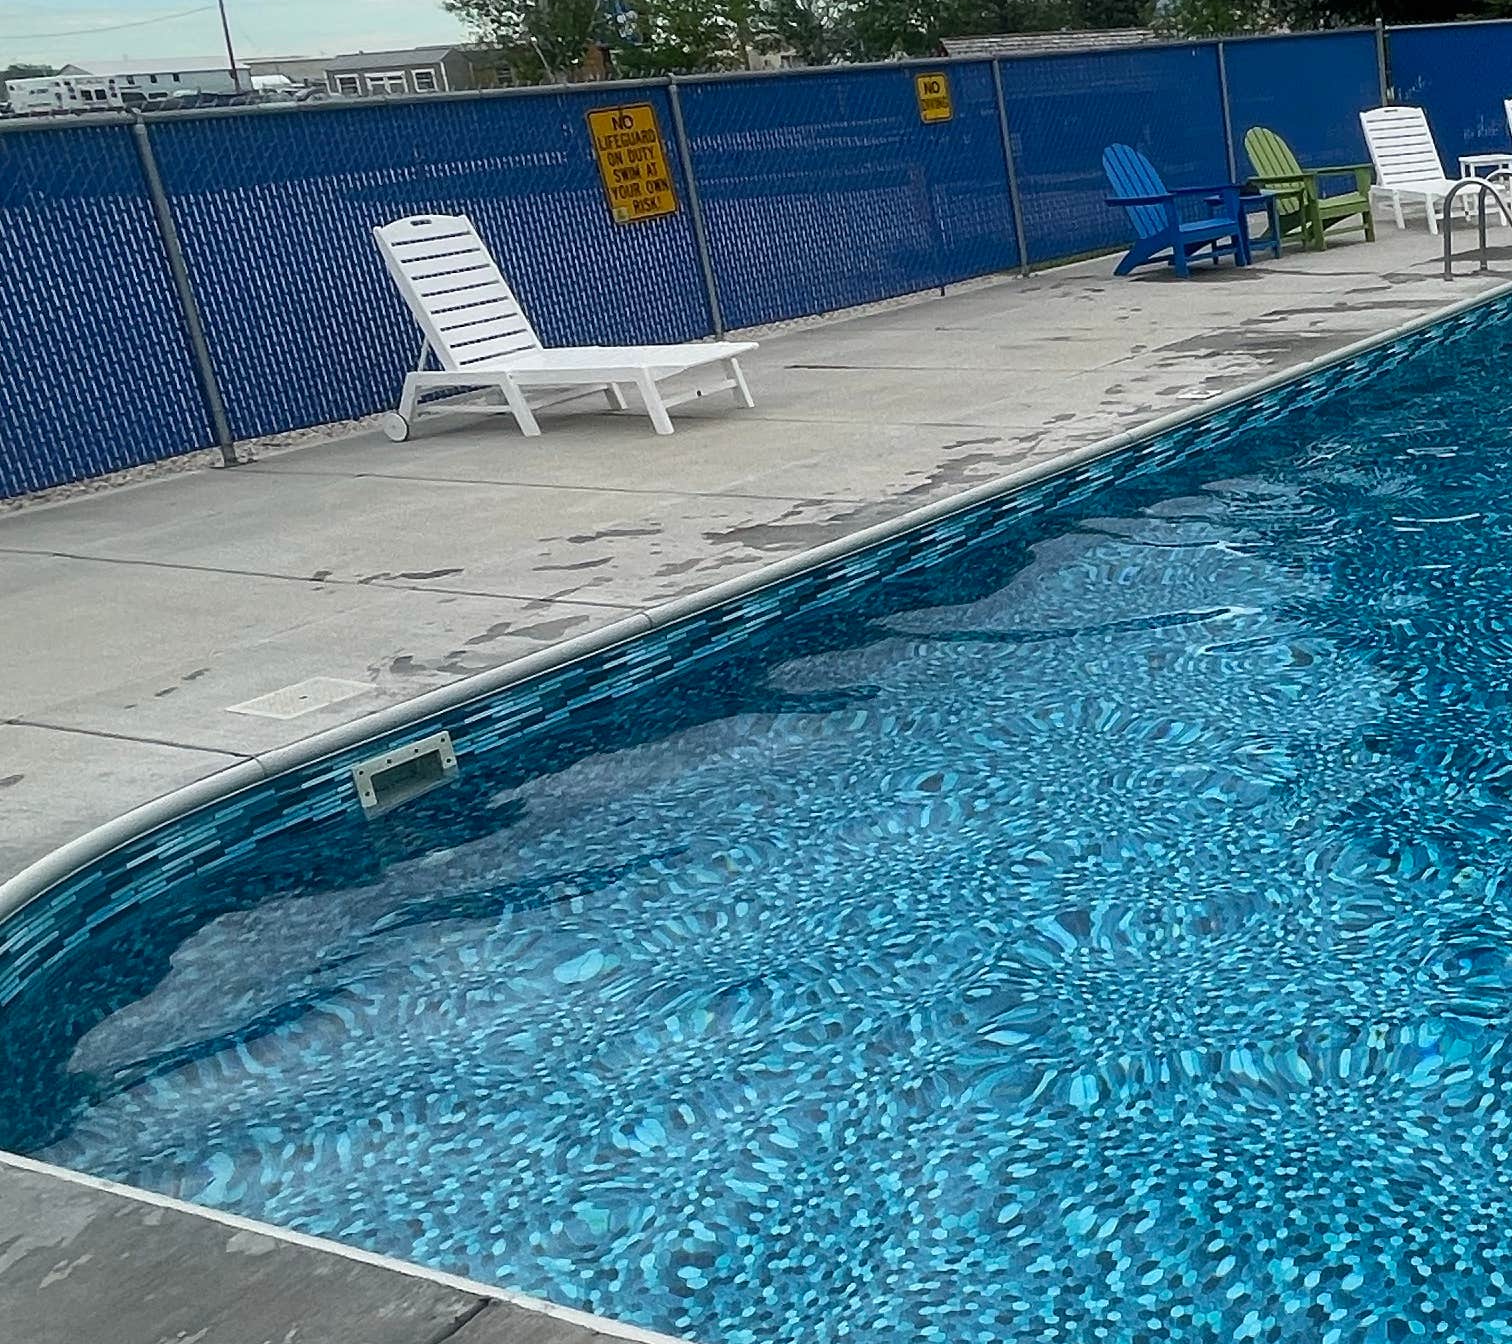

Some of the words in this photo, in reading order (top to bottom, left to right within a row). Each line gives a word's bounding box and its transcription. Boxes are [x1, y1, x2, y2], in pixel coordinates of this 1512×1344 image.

[923, 80, 941, 95] NO
[611, 115, 634, 131] NO
[597, 128, 656, 151] LIFEGUARD
[606, 152, 624, 167] ON
[627, 146, 655, 163] DUTY
[613, 167, 642, 183] SWIM
[646, 162, 659, 176] AT
[610, 182, 642, 201] YOUR
[645, 178, 670, 194] OWN
